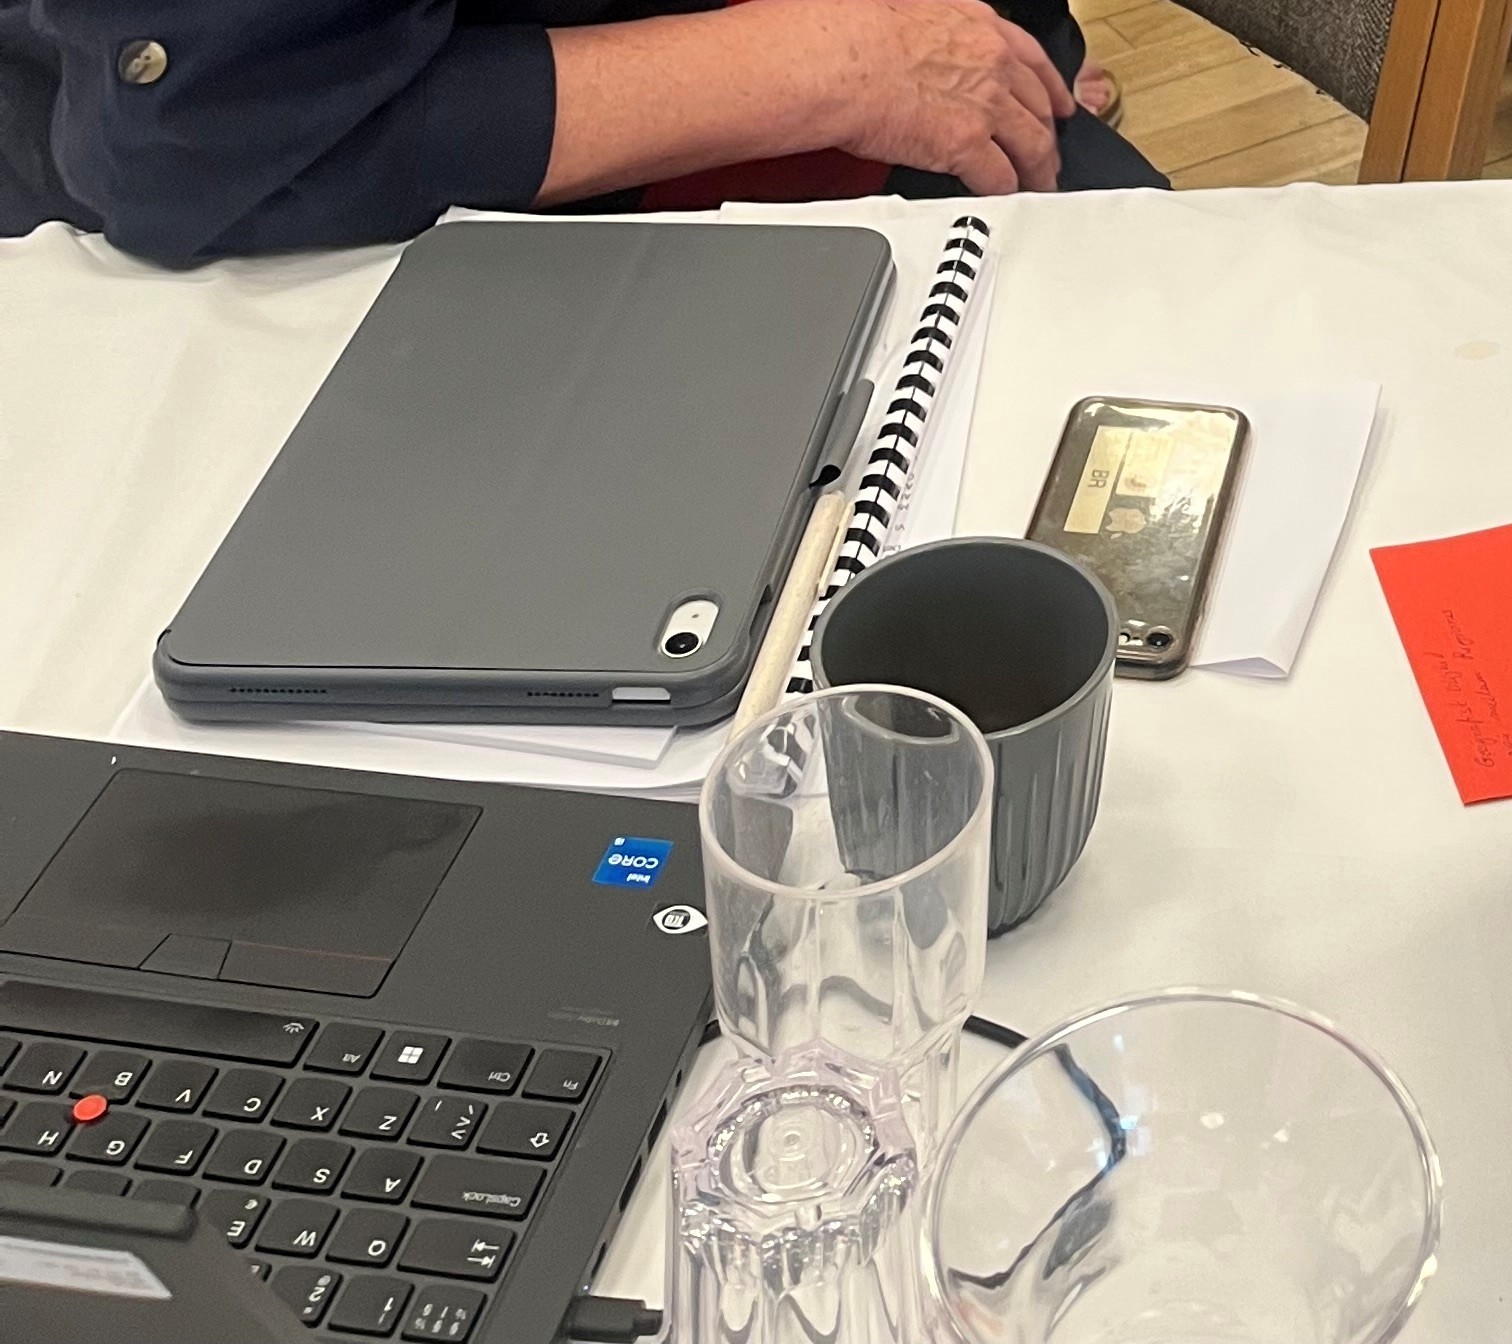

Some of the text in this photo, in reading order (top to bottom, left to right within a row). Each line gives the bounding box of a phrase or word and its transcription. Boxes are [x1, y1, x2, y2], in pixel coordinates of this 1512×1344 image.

[1088, 469, 1110, 489] BR
[342, 1053, 361, 1064] Alt
[41, 1070, 63, 1085] N
[114, 1071, 133, 1086] B
[487, 1071, 511, 1083] Ctrl
[562, 1080, 579, 1090] Fn
[174, 1089, 191, 1103] V
[243, 1097, 262, 1112] C
[310, 1106, 330, 1121] X
[378, 1115, 398, 1131] Z
[37, 1130, 60, 1146] H
[105, 1140, 125, 1156] G
[174, 1150, 194, 1165] F
[244, 1159, 263, 1175] D
[313, 1168, 331, 1184] S
[385, 1177, 401, 1193] A
[226, 1220, 246, 1237] E
[292, 1230, 317, 1247] W
[367, 1239, 386, 1257] Q
[308, 1282, 328, 1302] 2
[383, 1297, 394, 1312] 1
